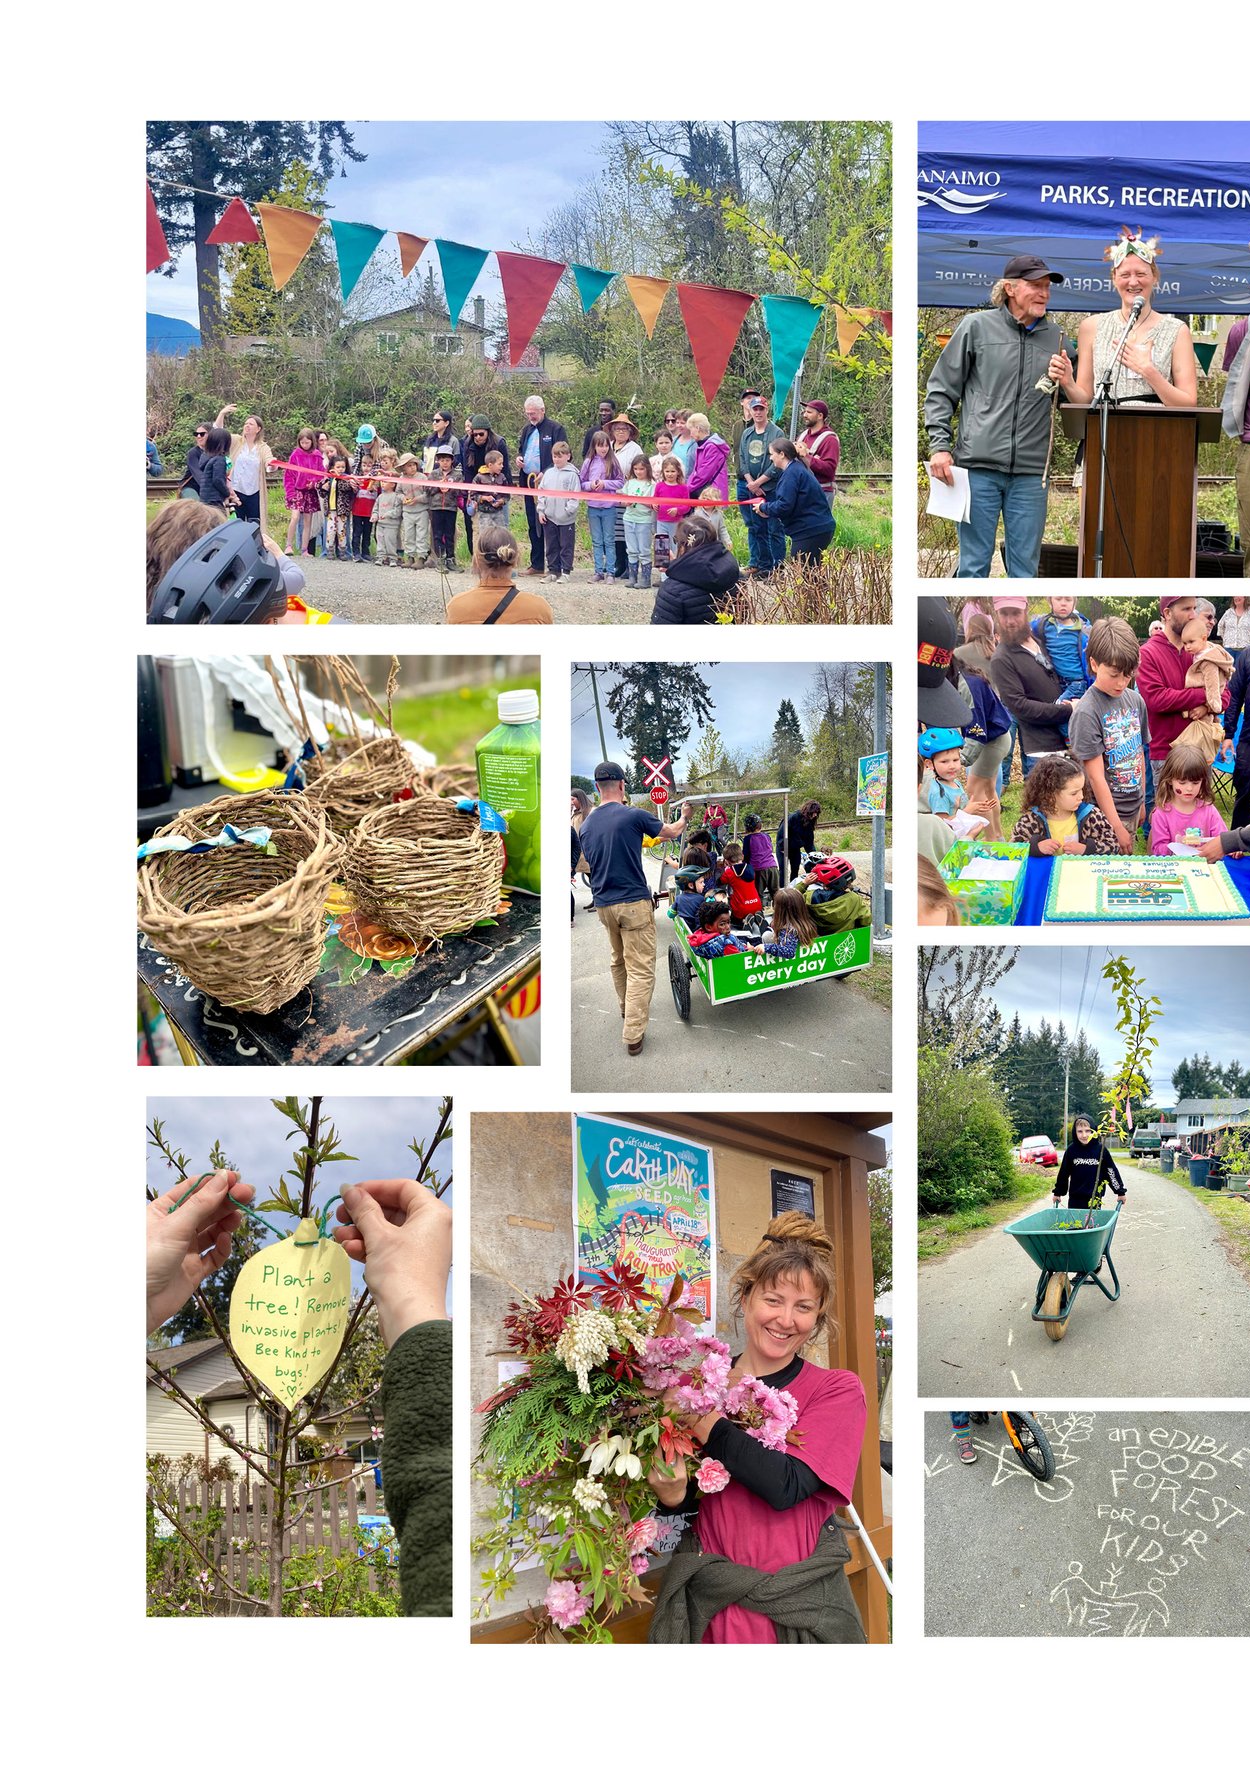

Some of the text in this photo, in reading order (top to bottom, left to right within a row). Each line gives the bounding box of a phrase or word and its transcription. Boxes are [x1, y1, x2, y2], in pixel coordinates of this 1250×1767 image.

[1041, 184, 1115, 208] PARKS,
[652, 791, 667, 800] STOP
[744, 940, 828, 970] EAR DAY
[747, 958, 827, 985] every day
[663, 1150, 695, 1195] DAY
[585, 1254, 600, 1268] 7th
[263, 1265, 332, 1288] Plant a
[244, 1293, 347, 1316] tree! Remove
[241, 1318, 341, 1346] invasive plants!
[255, 1343, 279, 1357] Bee
[311, 1346, 321, 1357] to
[275, 1363, 309, 1383] bugs!
[1106, 1427, 1141, 1445] an
[1122, 1446, 1218, 1480] FOOD
[1110, 1469, 1245, 1529] FOREST
[1097, 1504, 1207, 1561] FOR OUR
[1100, 1524, 1189, 1576] KIDS
